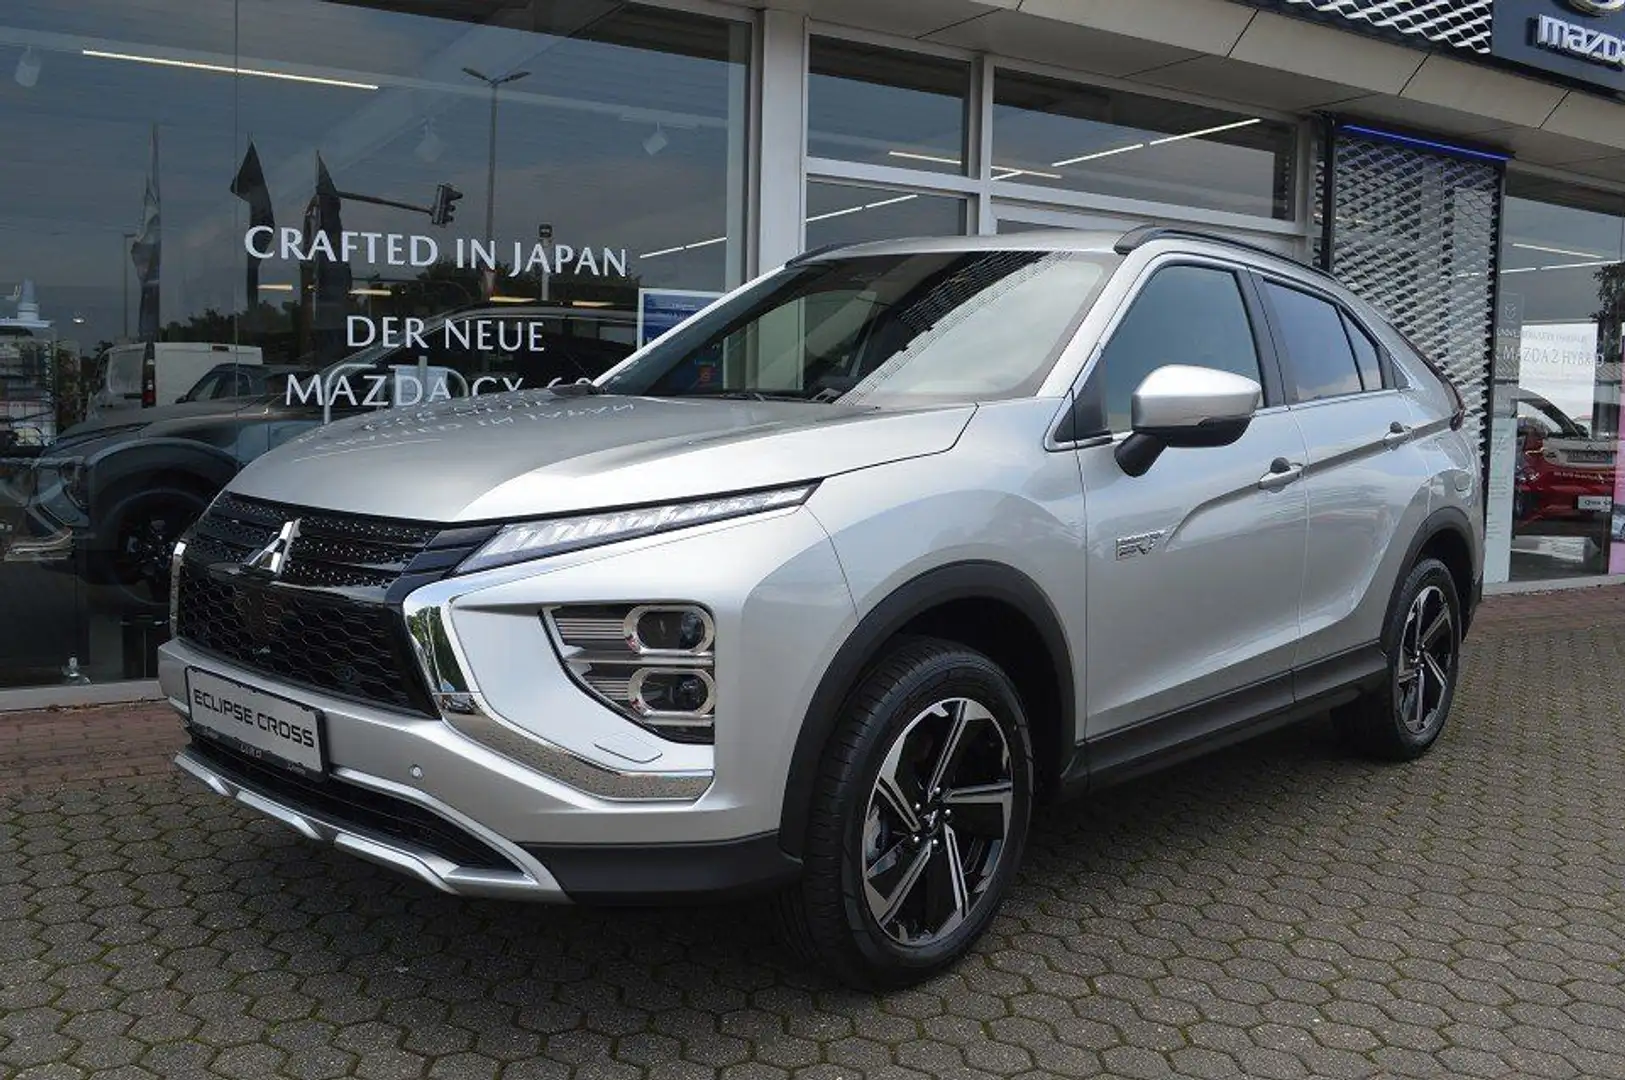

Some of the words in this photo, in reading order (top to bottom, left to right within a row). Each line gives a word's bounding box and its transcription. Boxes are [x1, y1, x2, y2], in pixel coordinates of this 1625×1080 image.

[1537, 14, 1625, 64] mazd
[244, 225, 438, 267] CRAFTED
[456, 238, 497, 271] IN
[508, 241, 627, 278] JAPAN
[346, 315, 430, 349] DER
[444, 318, 545, 352] NEUE
[1562, 350, 1605, 367] HYBRD
[285, 373, 452, 407] MAZDA
[193, 689, 253, 726] ECLIPSE
[257, 712, 315, 748] CROSS
